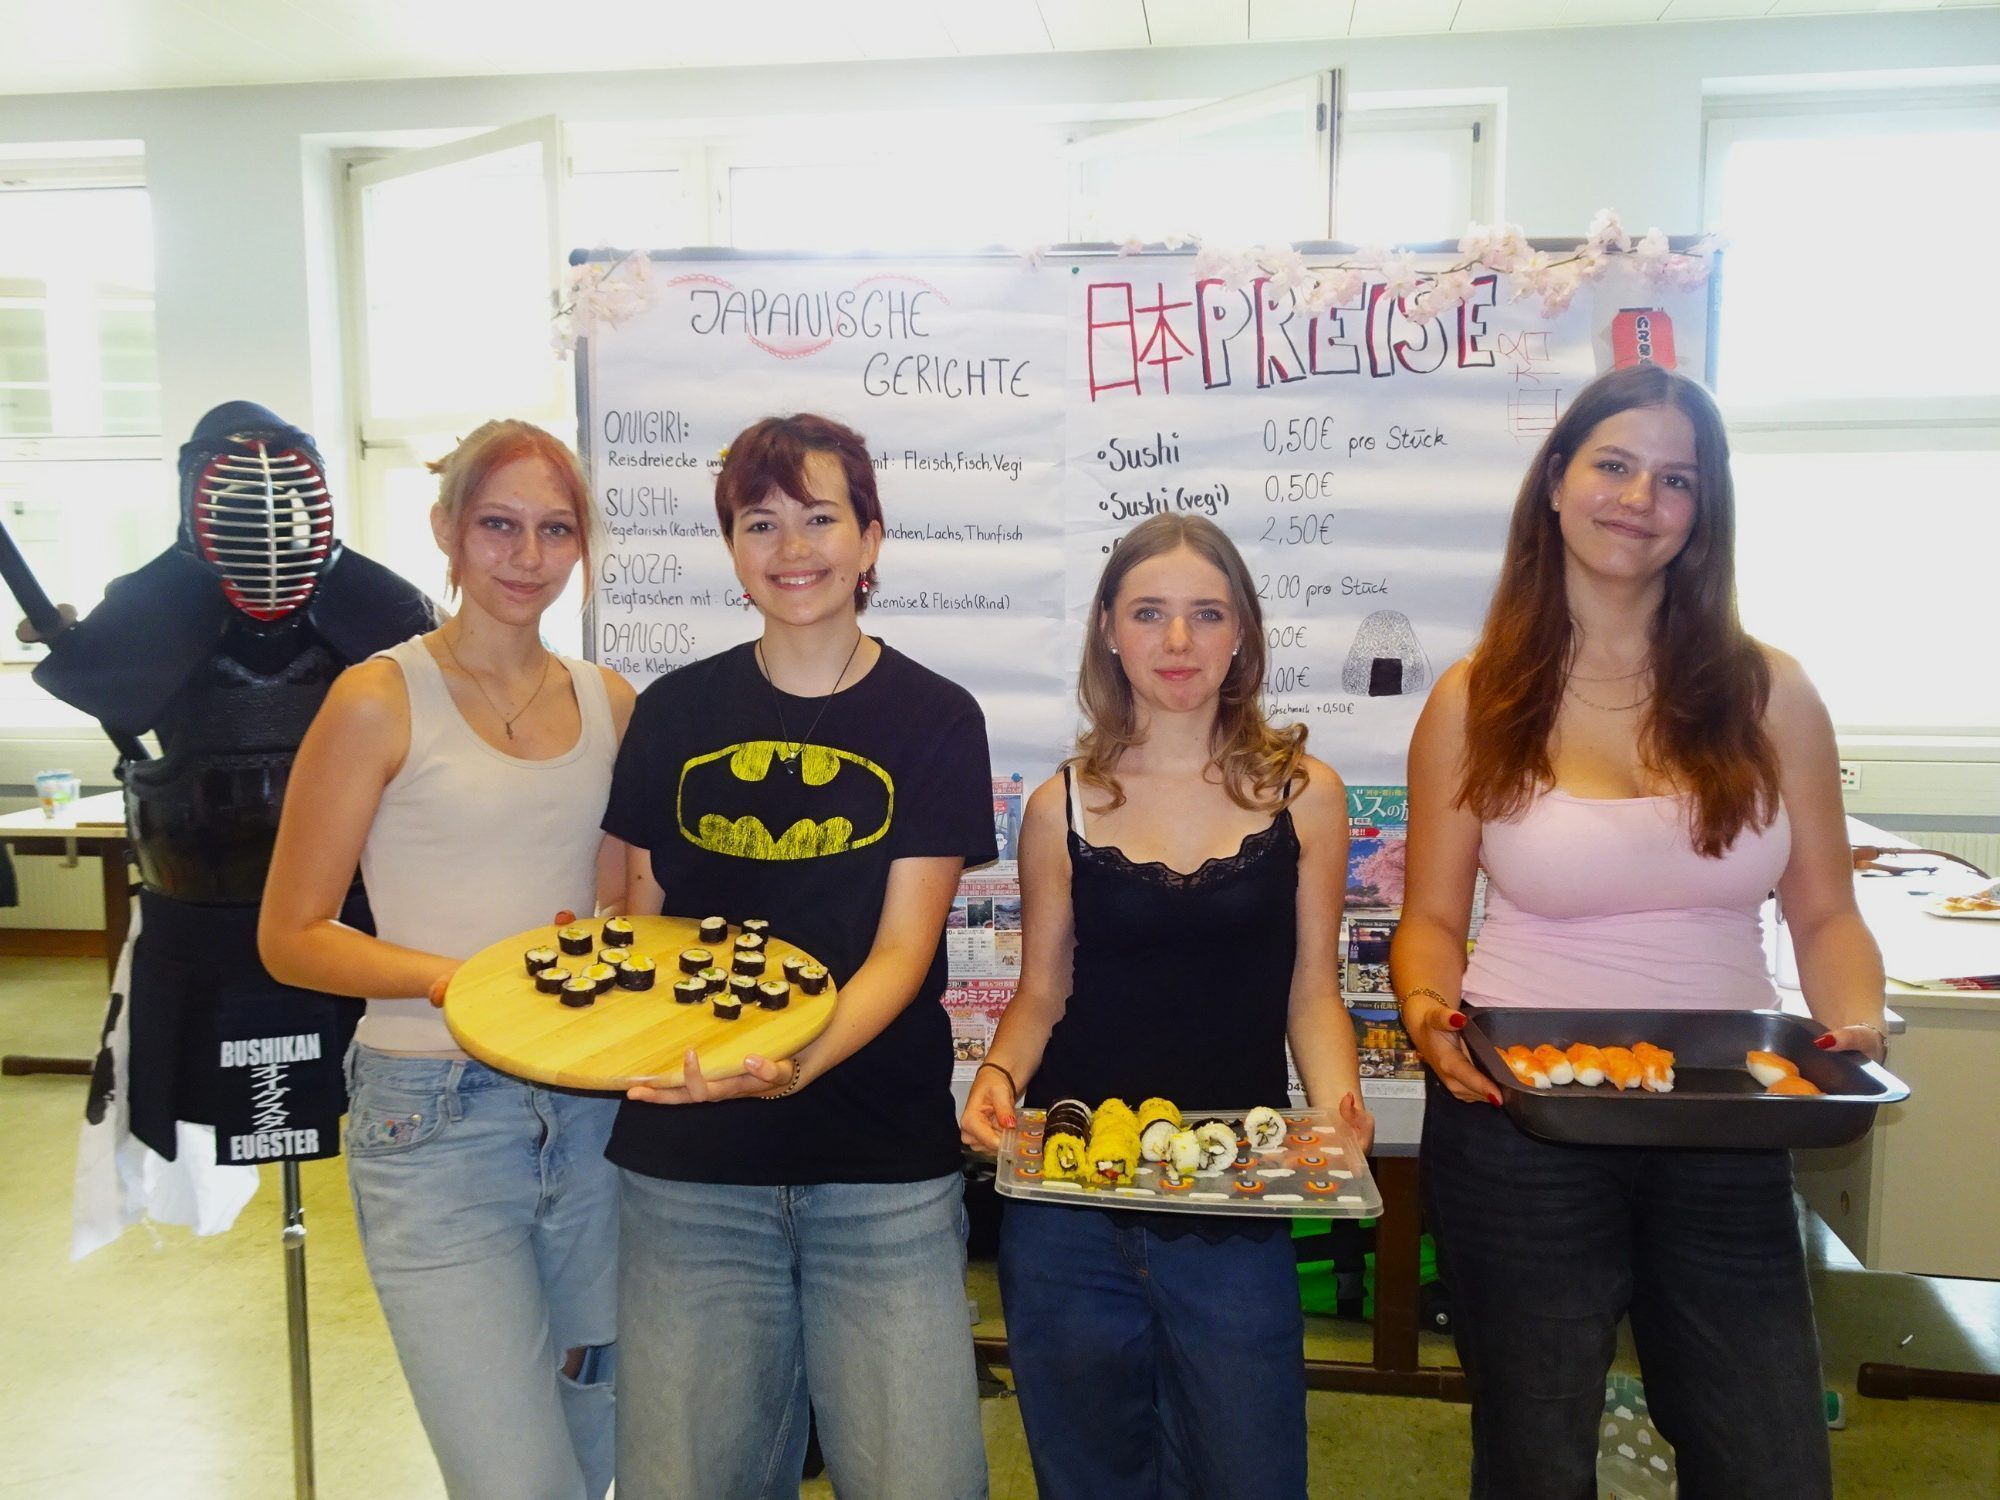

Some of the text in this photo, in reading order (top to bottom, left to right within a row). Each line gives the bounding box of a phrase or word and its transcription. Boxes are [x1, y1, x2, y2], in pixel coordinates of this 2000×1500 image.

[691, 289, 931, 339] JAPANISCHE
[1088, 282, 1194, 401] 日本
[1196, 275, 1498, 389] PREISE
[864, 353, 1030, 398] GERICHTE
[604, 410, 690, 445] ONIGIRI:
[1263, 416, 1335, 455] 0,50€
[1349, 436, 1376, 458] pro
[608, 450, 698, 467] Reisdreiecke
[1109, 432, 1180, 471] Sushi
[605, 486, 678, 518] SUSHI:
[1110, 483, 1229, 520] Sushi (vegi)
[1265, 471, 1334, 503] 0,50€
[1259, 513, 1335, 545] 2,50€
[602, 553, 682, 584] GYOZA:
[601, 587, 684, 613] Teigtaschen
[1258, 574, 1300, 600] 2,00
[1305, 583, 1332, 607] pro
[603, 622, 696, 655] DANGOS:
[1267, 626, 1308, 649] 00€
[220, 1033, 322, 1068] BUSHIKAN
[230, 1129, 320, 1161] EUGSTER
